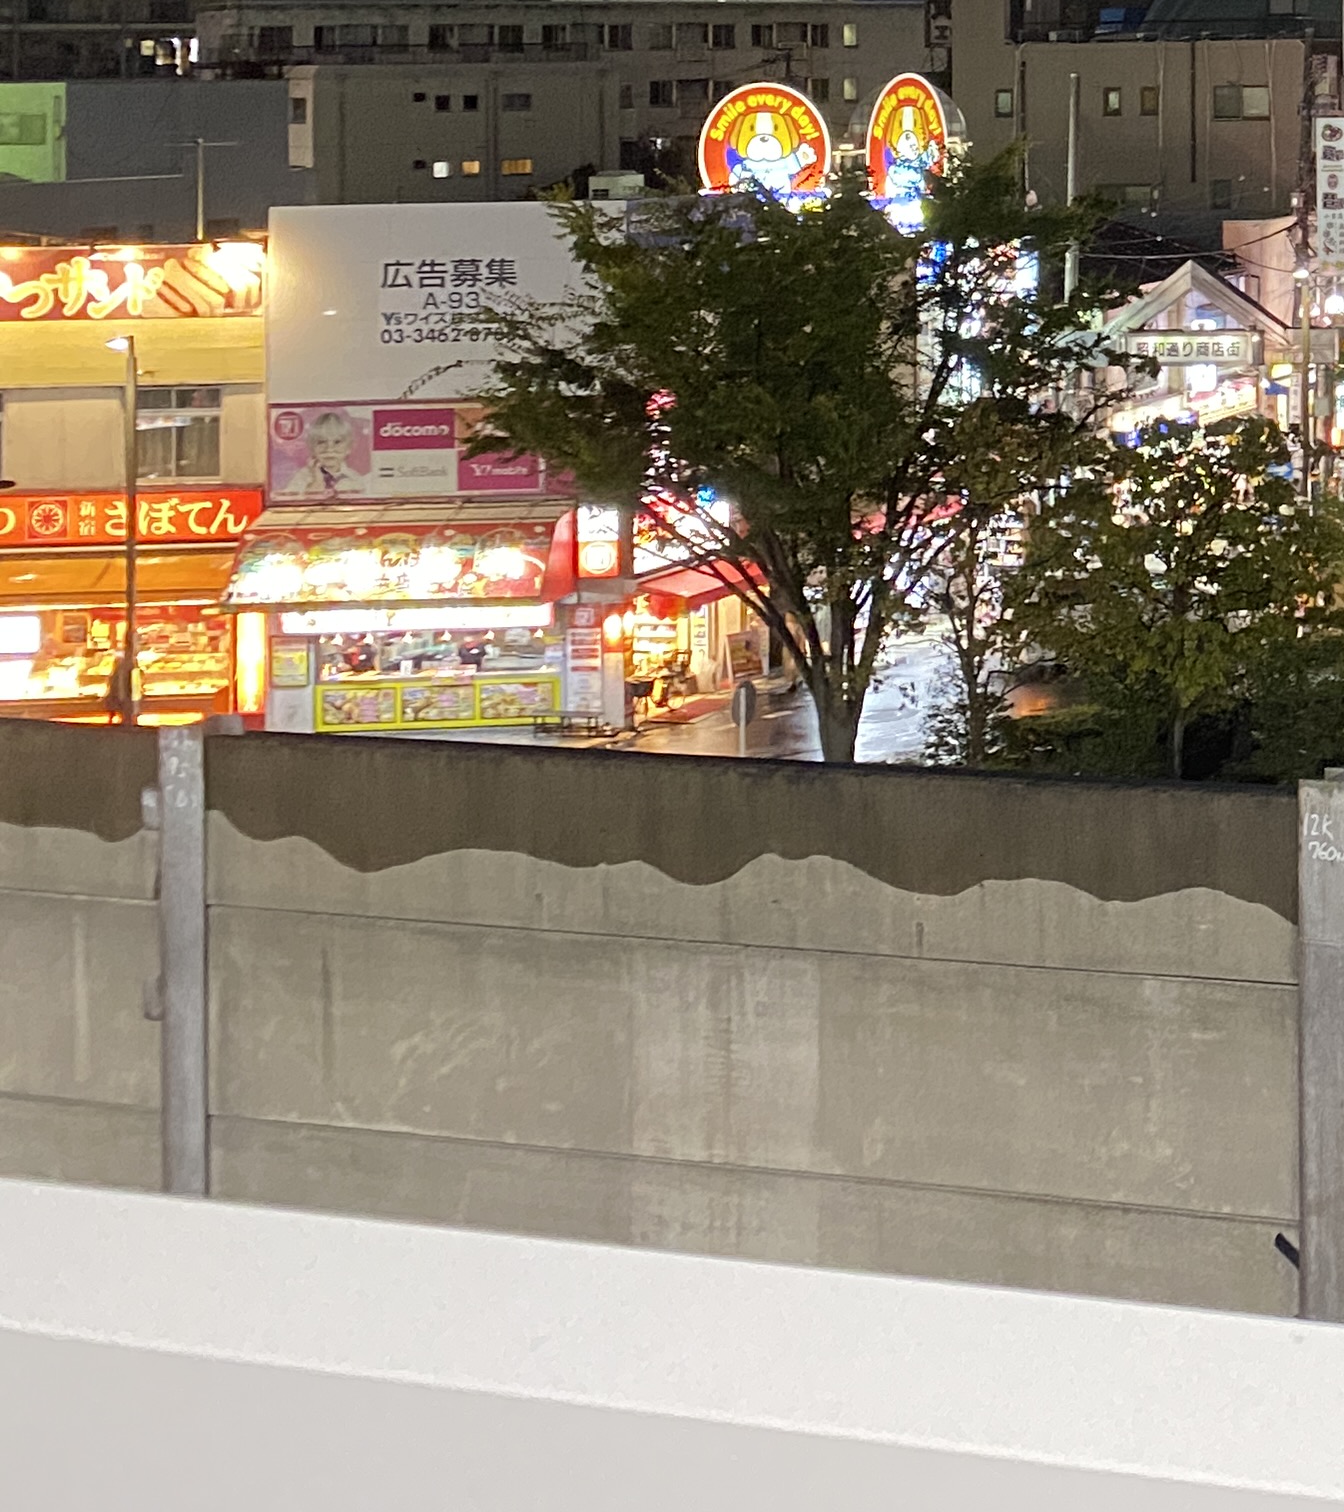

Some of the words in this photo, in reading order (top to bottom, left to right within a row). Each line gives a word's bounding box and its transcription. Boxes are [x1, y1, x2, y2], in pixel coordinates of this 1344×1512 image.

[710, 102, 746, 142] Smile
[747, 93, 792, 113] every
[791, 106, 820, 140] day!
[381, 258, 517, 288] 広告募集
[422, 291, 480, 309] A-93
[1137, 342, 1240, 357] 昭和通り商店街
[379, 422, 450, 437] docomo
[396, 466, 447, 478] SoftBank
[104, 498, 249, 536] さぼてん
